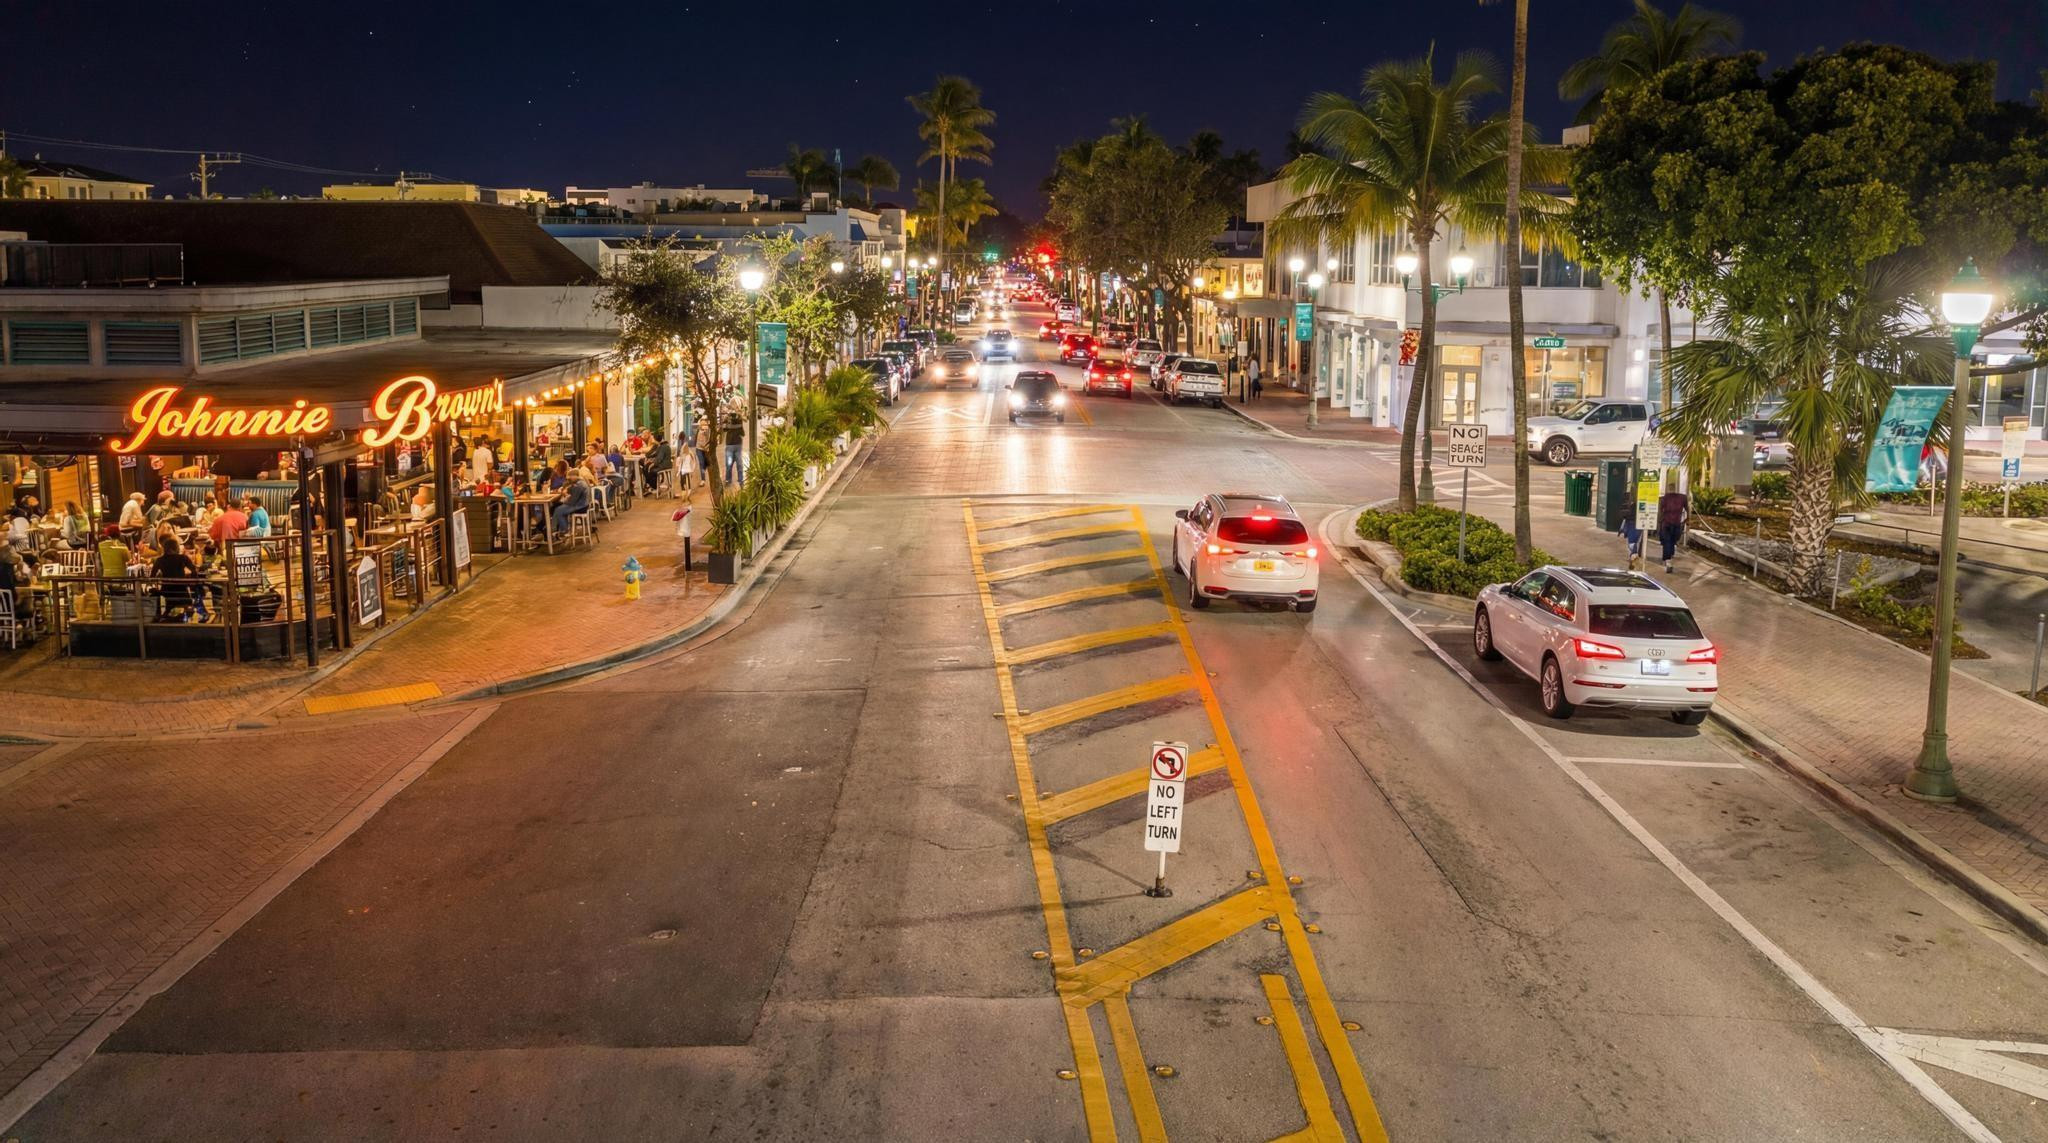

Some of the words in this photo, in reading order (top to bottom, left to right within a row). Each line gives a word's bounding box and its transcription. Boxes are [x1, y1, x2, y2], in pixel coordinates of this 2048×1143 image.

[111, 386, 330, 454] Johnnie
[362, 375, 504, 449] Brown's
[1451, 455, 1484, 464] TURN
[1156, 785, 1175, 799] NO
[1150, 804, 1178, 819] LEFT
[1148, 824, 1178, 840] TURN
